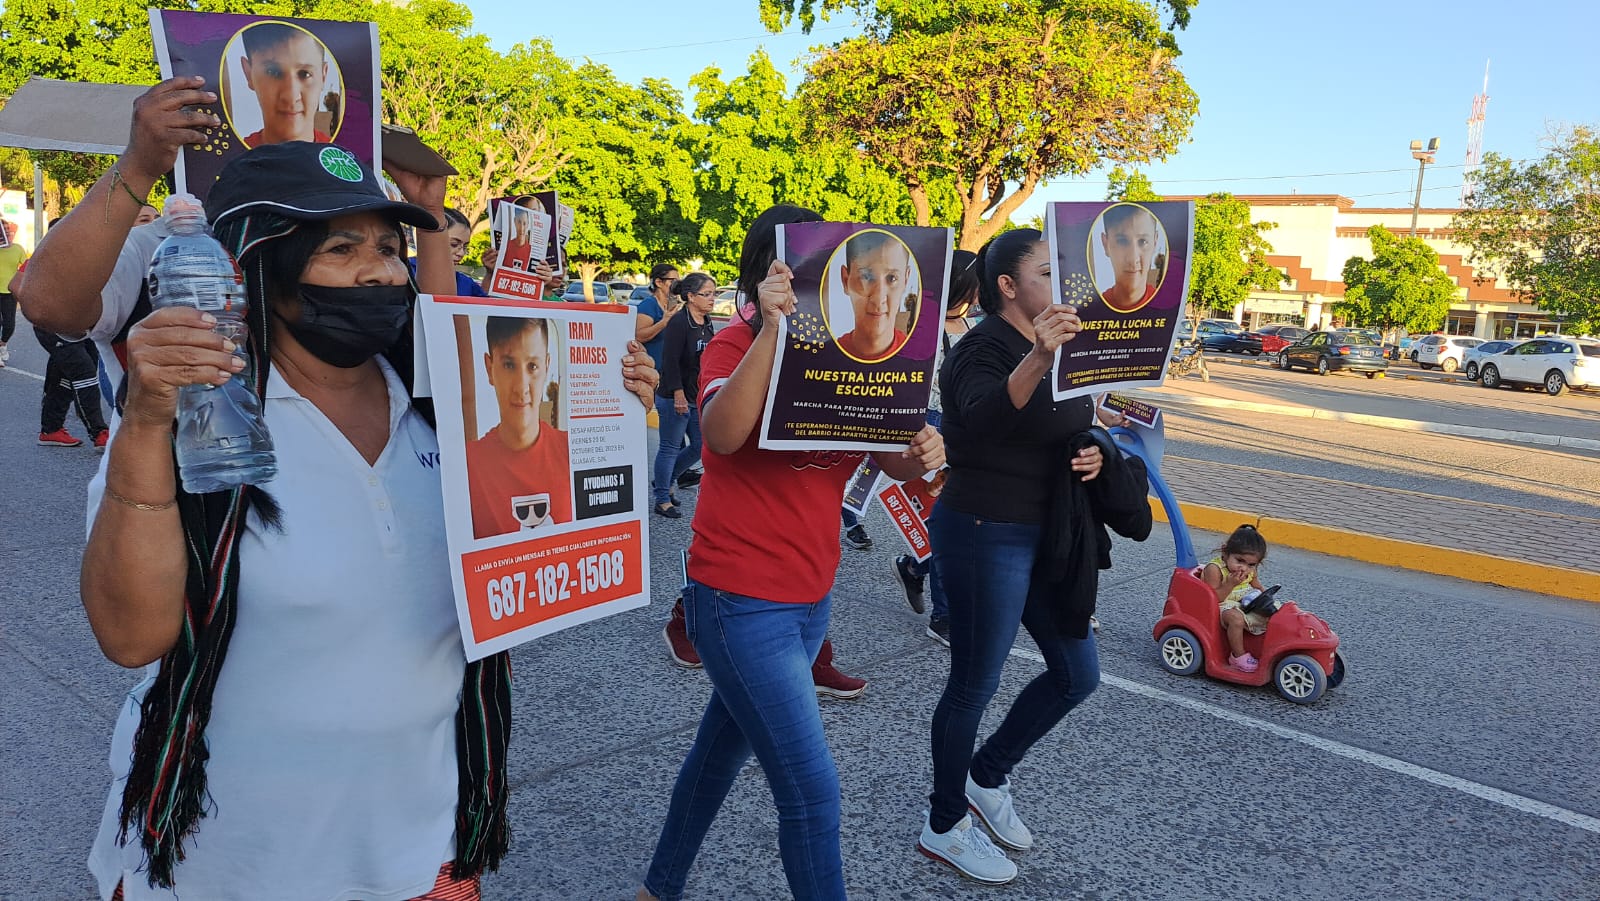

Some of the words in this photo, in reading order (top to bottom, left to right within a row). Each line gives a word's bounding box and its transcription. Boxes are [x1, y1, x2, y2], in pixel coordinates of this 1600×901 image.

[569, 322, 593, 340] IRAM
[1080, 320, 1119, 329] NUESTRA
[1122, 319, 1152, 328] LUCHA
[1155, 318, 1166, 327] SE
[1098, 331, 1140, 340] ESCUCHA
[570, 347, 607, 364] RAMSES
[805, 370, 864, 382] NUESTRA
[868, 372, 906, 382] LUCHA
[911, 372, 924, 382] SE
[836, 384, 894, 396] ESCUCHA
[584, 474, 618, 490] AYUDANOS
[620, 474, 624, 486] A
[589, 491, 618, 506] DIFUNDIR
[887, 495, 925, 548] 687-182-1508
[474, 563, 492, 572] LLAMA
[498, 557, 514, 567] ENVÍA
[523, 550, 545, 560] MENSAJE
[552, 546, 569, 554] TIENES
[570, 539, 597, 551] CUALQUIER
[598, 533, 631, 544] INFORMACIÓN
[487, 550, 624, 620] 687-182-1508
